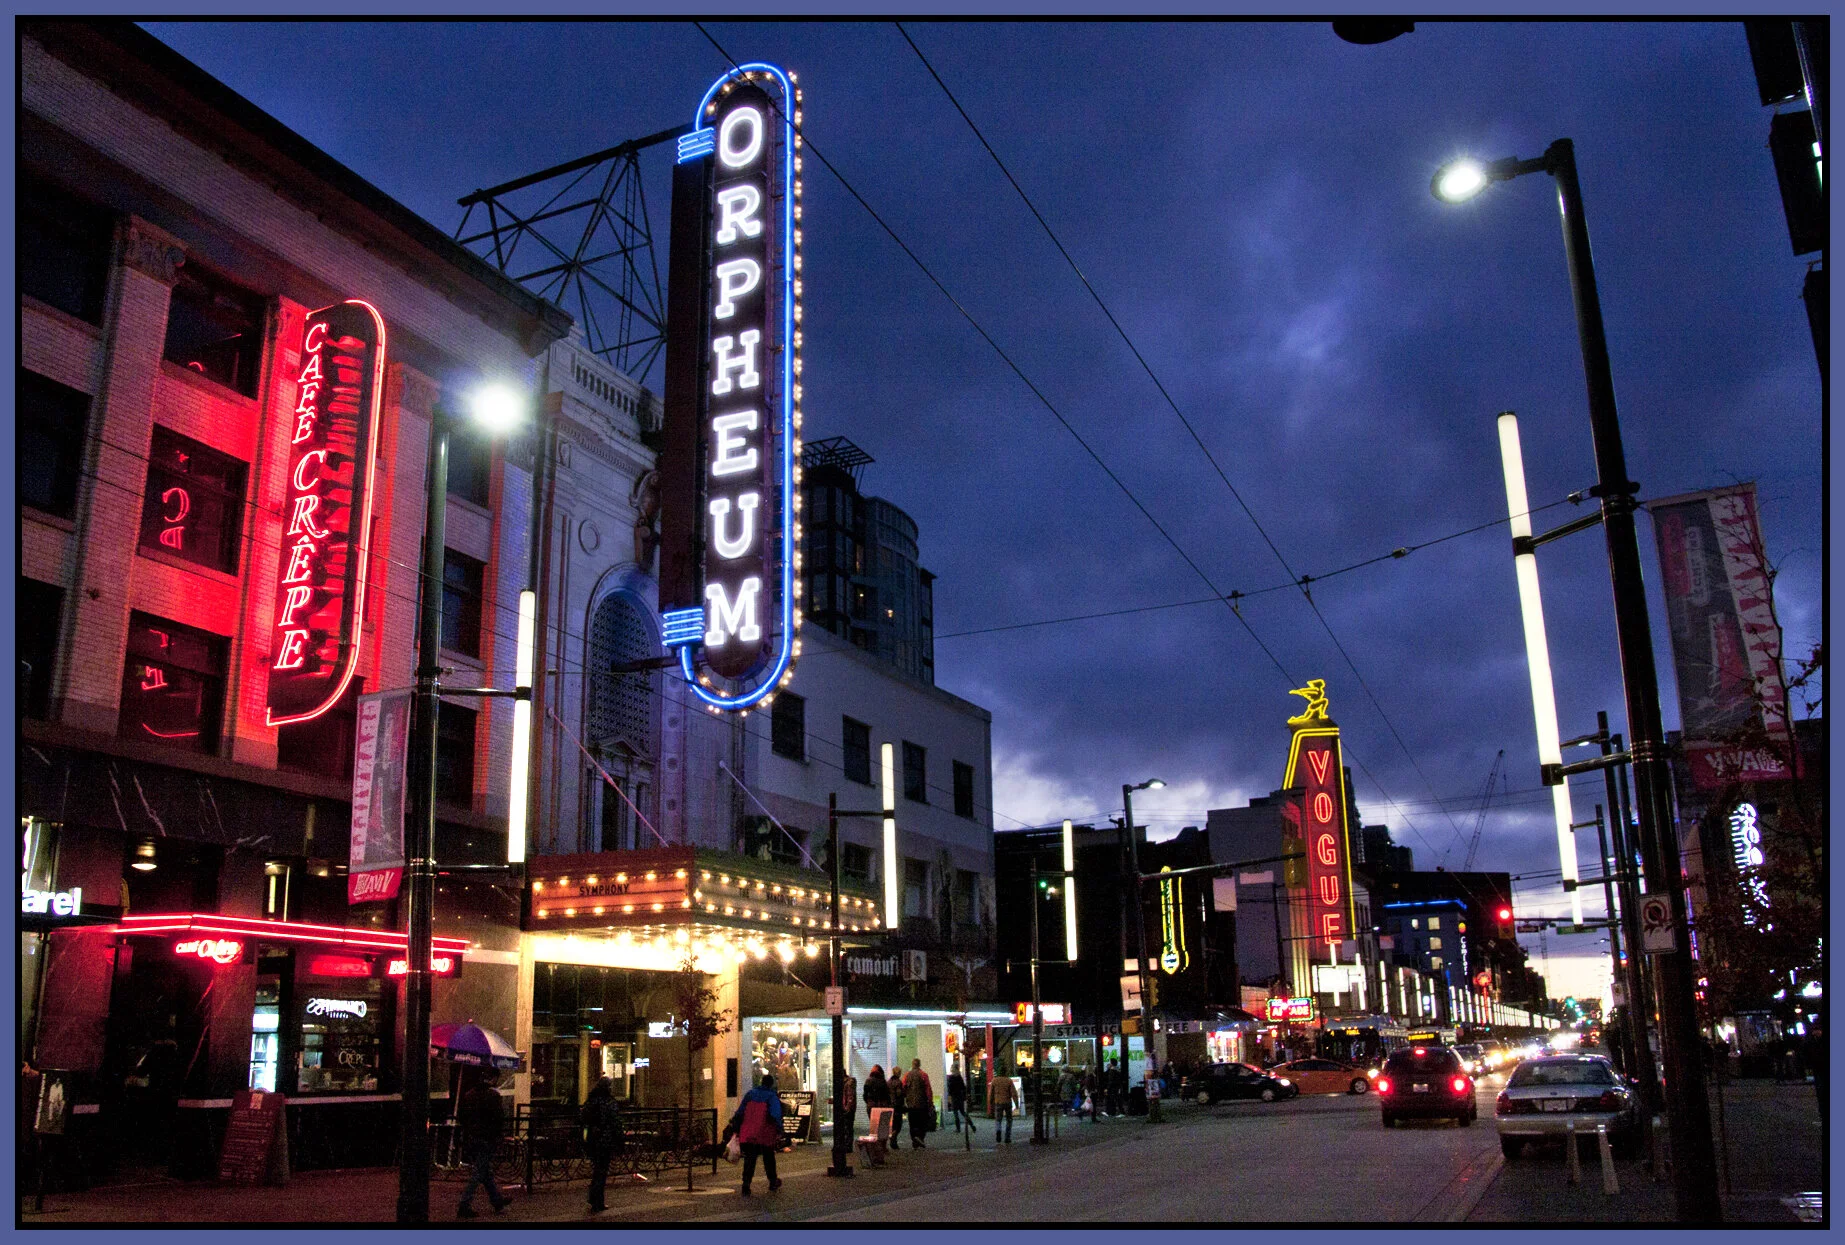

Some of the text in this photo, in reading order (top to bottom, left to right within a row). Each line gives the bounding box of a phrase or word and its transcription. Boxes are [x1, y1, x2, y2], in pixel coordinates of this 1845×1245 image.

[704, 105, 763, 648] ORPHEUM
[273, 322, 329, 670] CAFÉ CRÊPE
[578, 883, 630, 897] SYMPHONY
[1308, 750, 1342, 945] VOGUE
[1271, 1006, 1309, 1017] AADE
